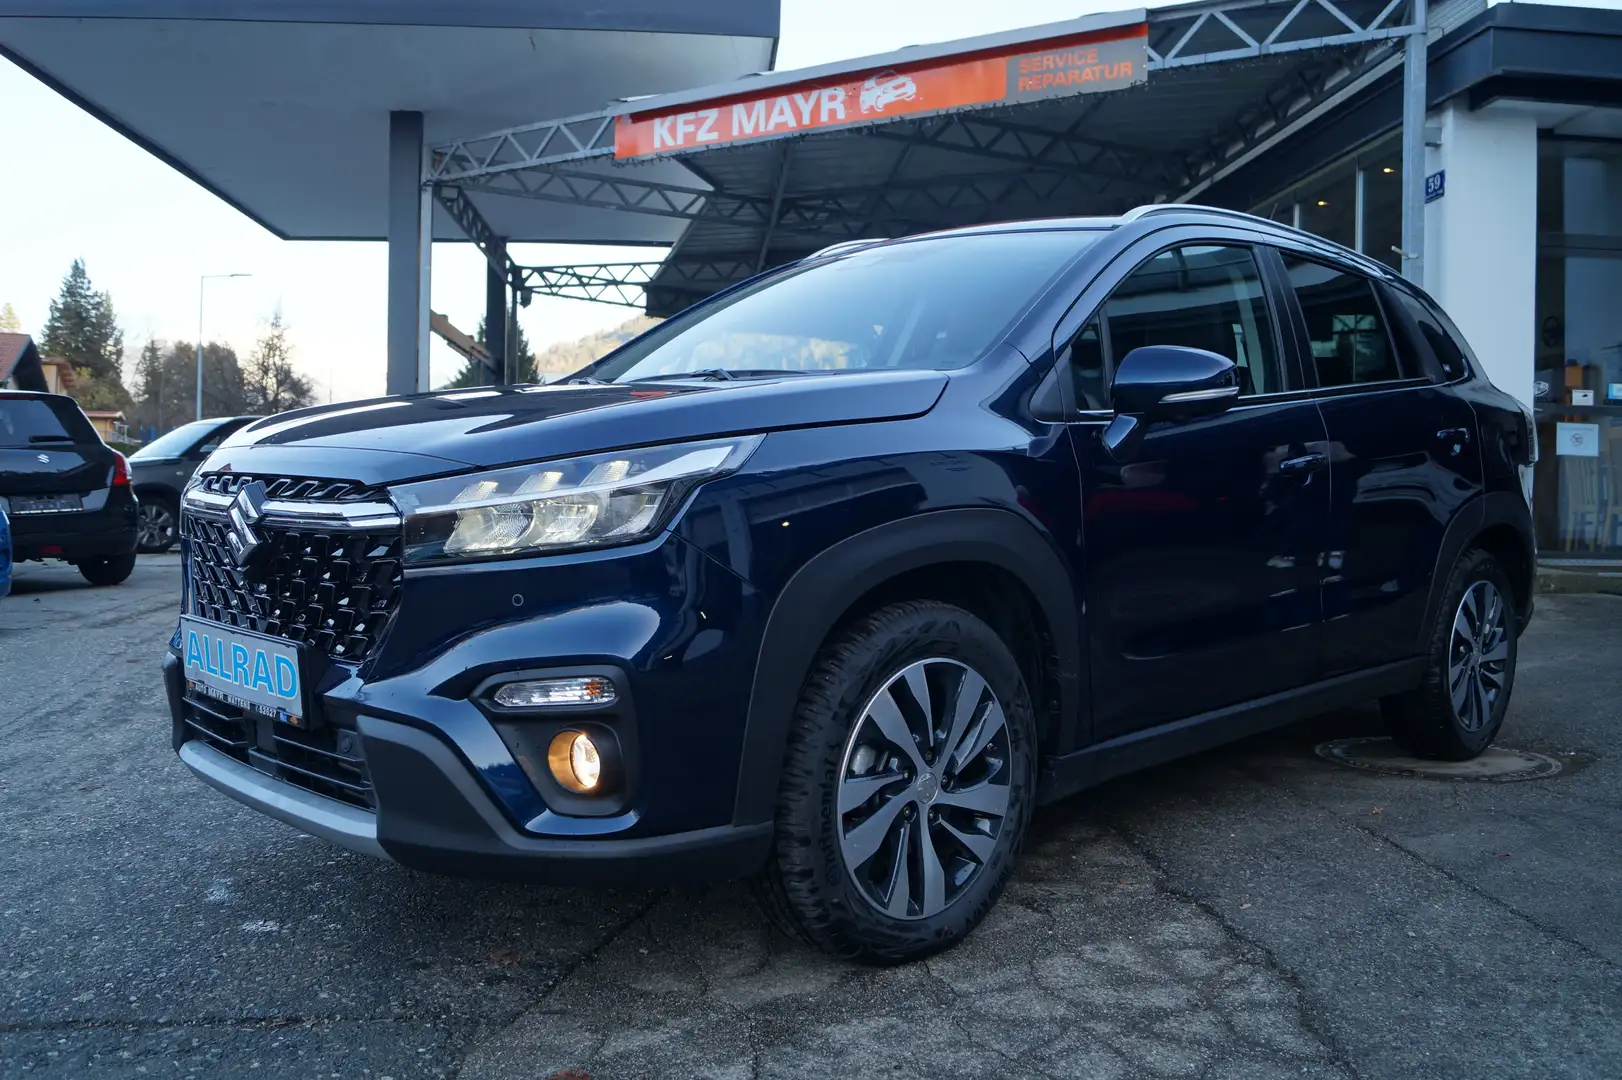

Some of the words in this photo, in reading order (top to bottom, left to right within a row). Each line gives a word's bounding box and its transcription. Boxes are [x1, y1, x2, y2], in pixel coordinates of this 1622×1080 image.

[1018, 61, 1132, 92] REPARATUR
[1019, 48, 1098, 74] SERVICE
[653, 108, 720, 148] KFZ
[732, 86, 846, 136] MAYR
[1428, 174, 1441, 193] 59
[186, 631, 298, 700] ALLRAD
